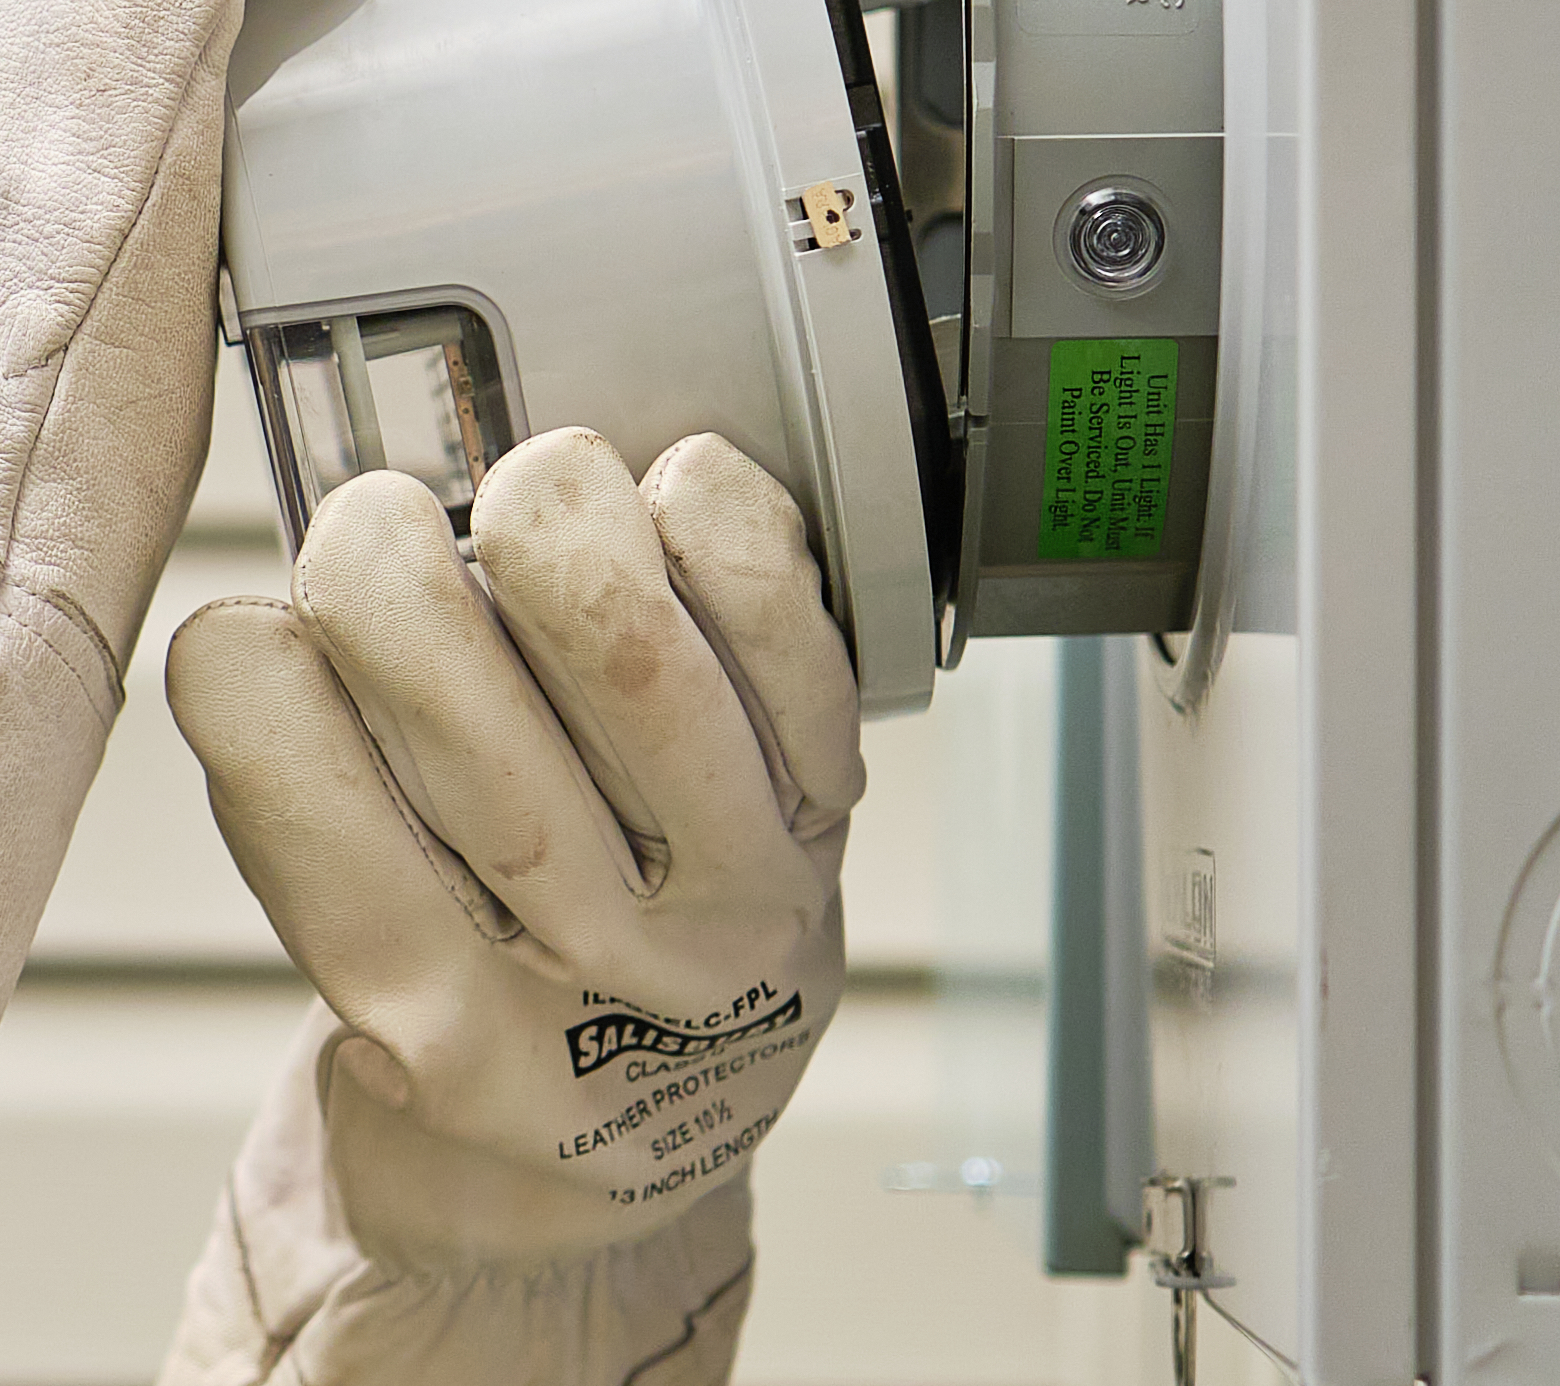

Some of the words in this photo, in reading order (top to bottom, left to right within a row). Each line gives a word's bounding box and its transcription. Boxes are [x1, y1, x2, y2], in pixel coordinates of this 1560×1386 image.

[1091, 369, 1112, 397] Be
[1113, 354, 1141, 407] Light
[1146, 373, 1169, 416] Unit
[1060, 386, 1083, 435] Paint
[1117, 414, 1138, 431] Is
[1084, 402, 1110, 484] Serviced.
[1110, 435, 1137, 474] Out,
[1143, 421, 1166, 457] Has
[1057, 440, 1080, 484] Over
[1048, 487, 1077, 531] Light.
[1081, 489, 1104, 514] Do
[1110, 478, 1133, 513] Unit
[1078, 516, 1101, 543] Not
[1105, 516, 1128, 551] Must
[1134, 526, 1155, 540] If
[557, 1099, 652, 1161] LEATHER
[651, 1030, 812, 1113] PROTECTORS
[642, 1160, 696, 1203] INCH
[700, 1109, 781, 1178] LENGTH
[650, 1125, 695, 1162] SIZE
